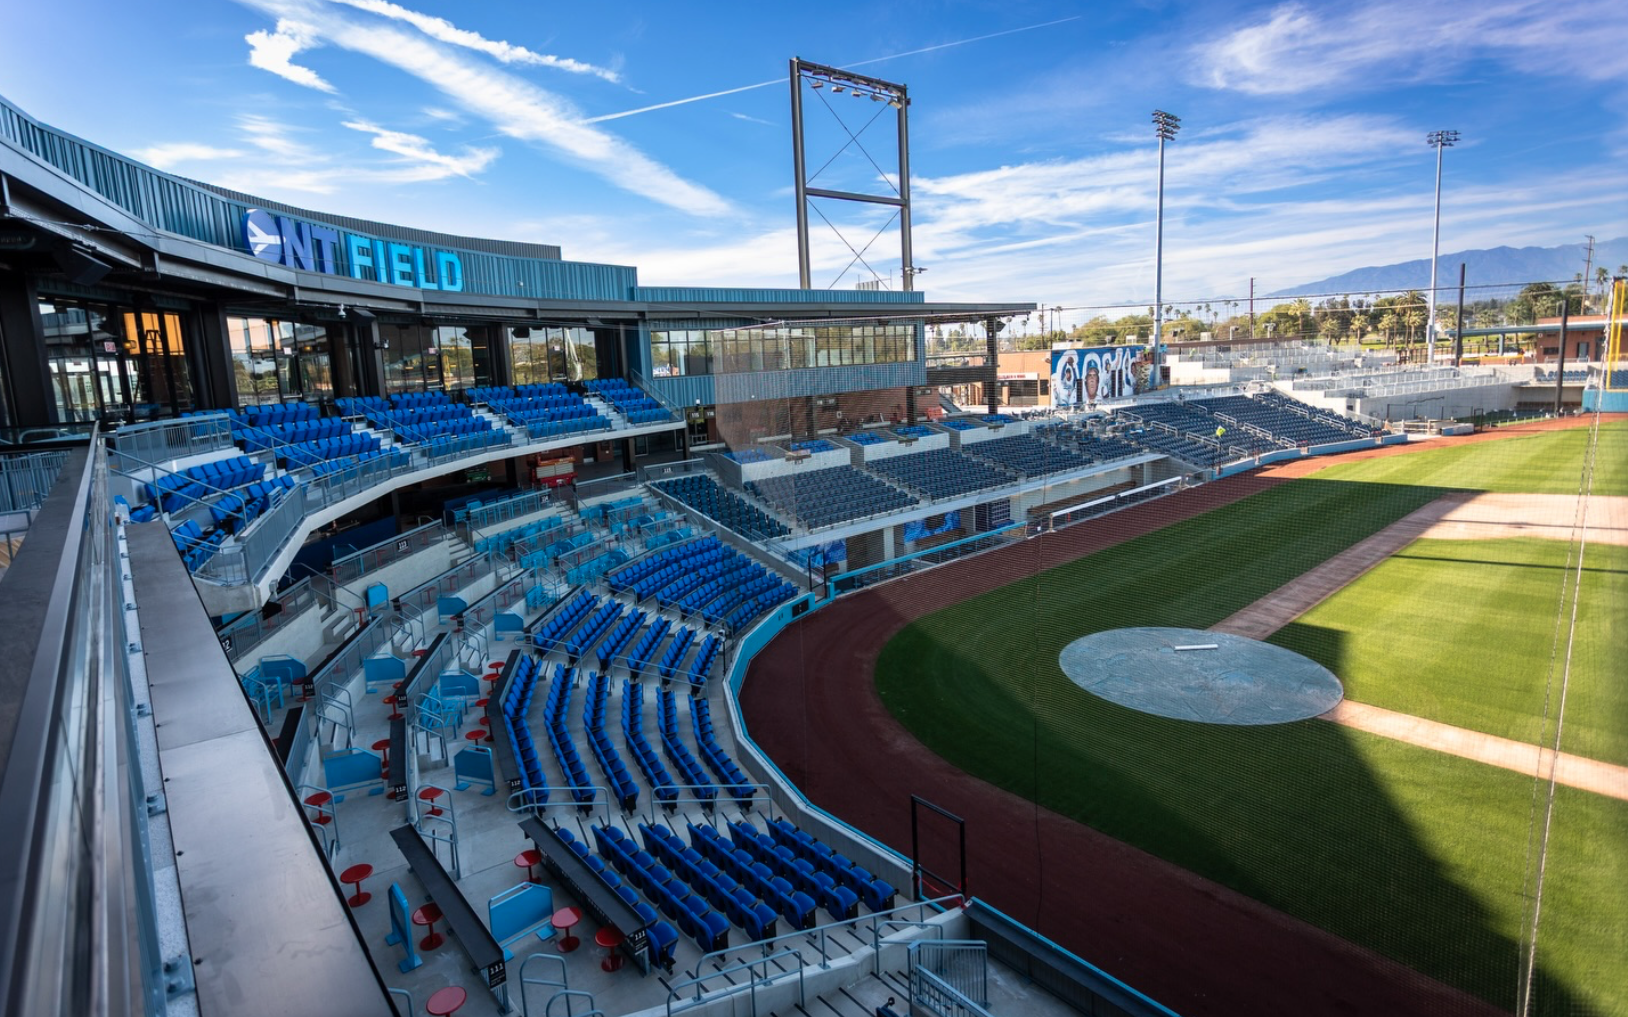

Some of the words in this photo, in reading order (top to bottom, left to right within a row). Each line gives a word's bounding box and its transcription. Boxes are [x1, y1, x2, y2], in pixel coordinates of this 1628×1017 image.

[345, 234, 464, 292] FIELD
[395, 785, 407, 793] 112
[634, 929, 646, 941] 111
[489, 962, 504, 975] 111
